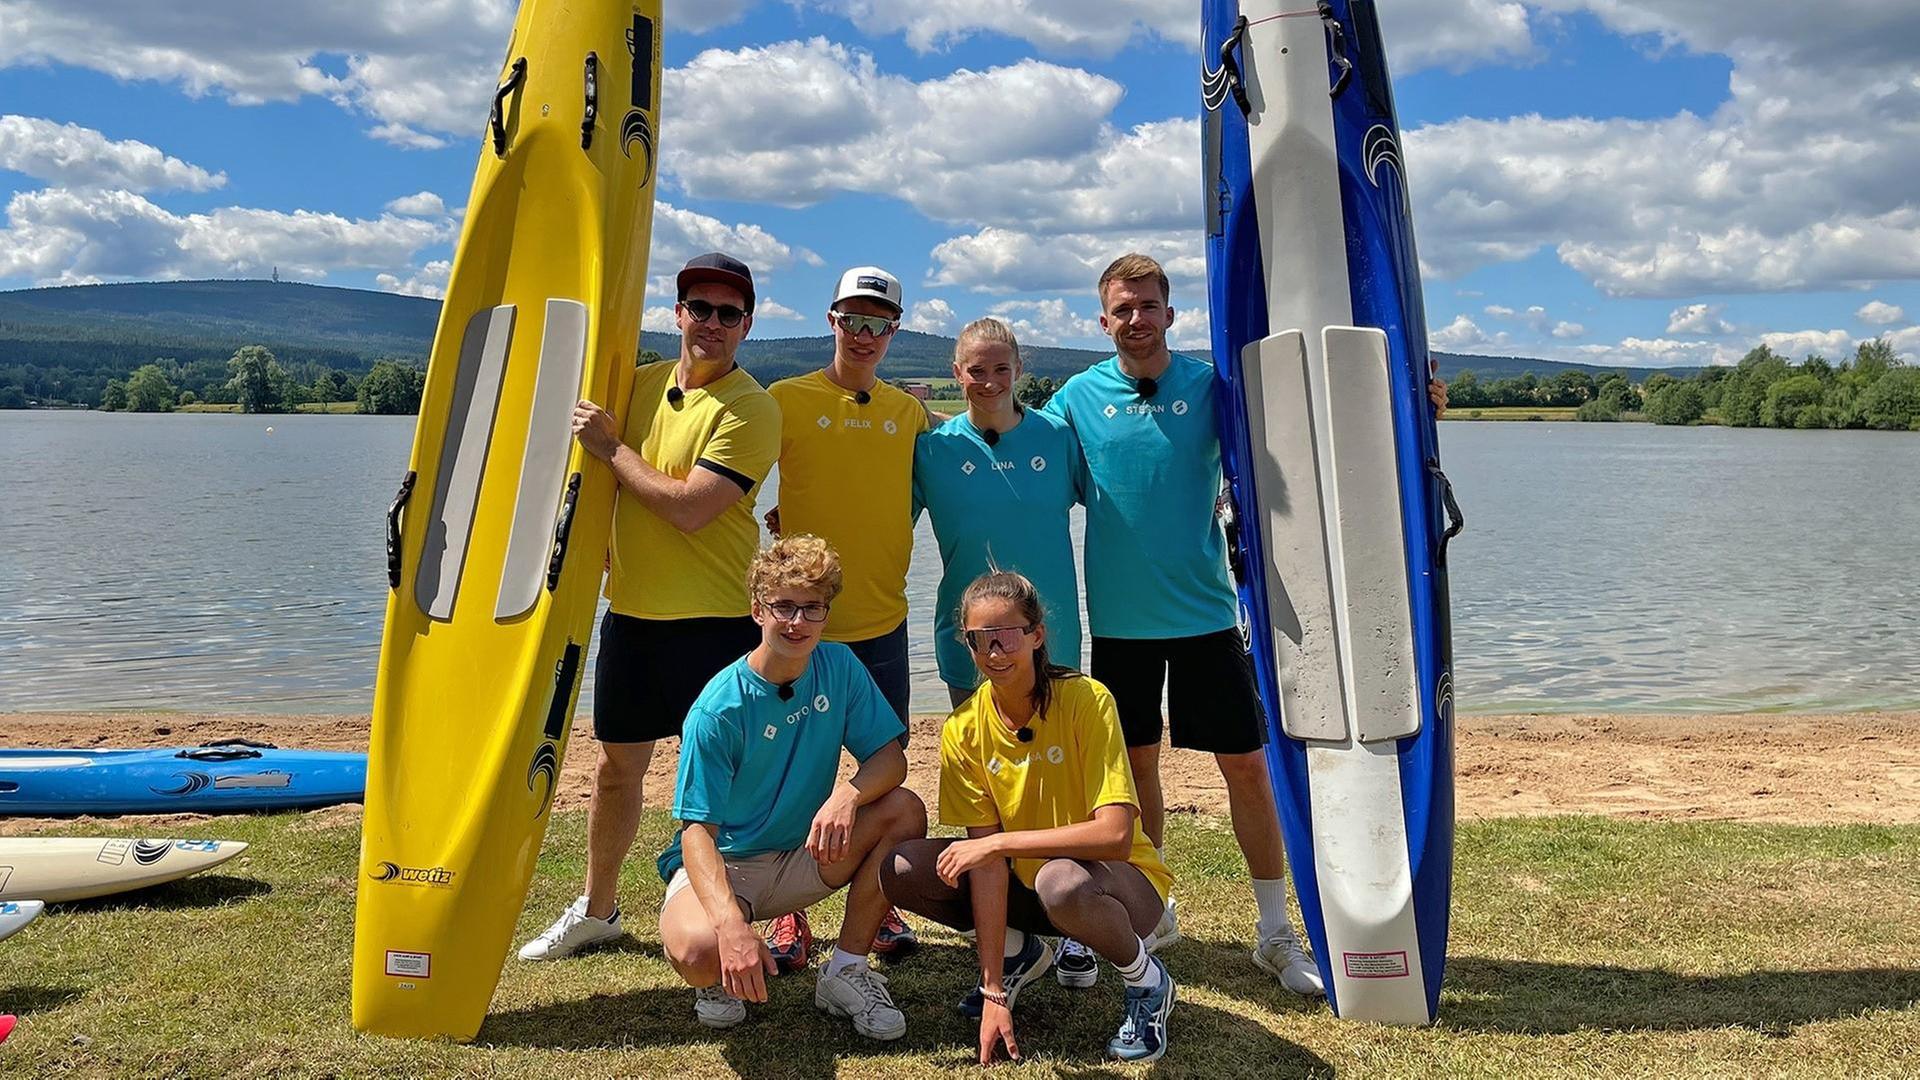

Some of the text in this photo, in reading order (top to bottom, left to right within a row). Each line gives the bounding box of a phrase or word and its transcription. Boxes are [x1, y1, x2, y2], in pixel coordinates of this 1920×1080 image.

[844, 418, 872, 430] FELIX
[991, 460, 1016, 471] LINA
[402, 867, 451, 883] wetiz
